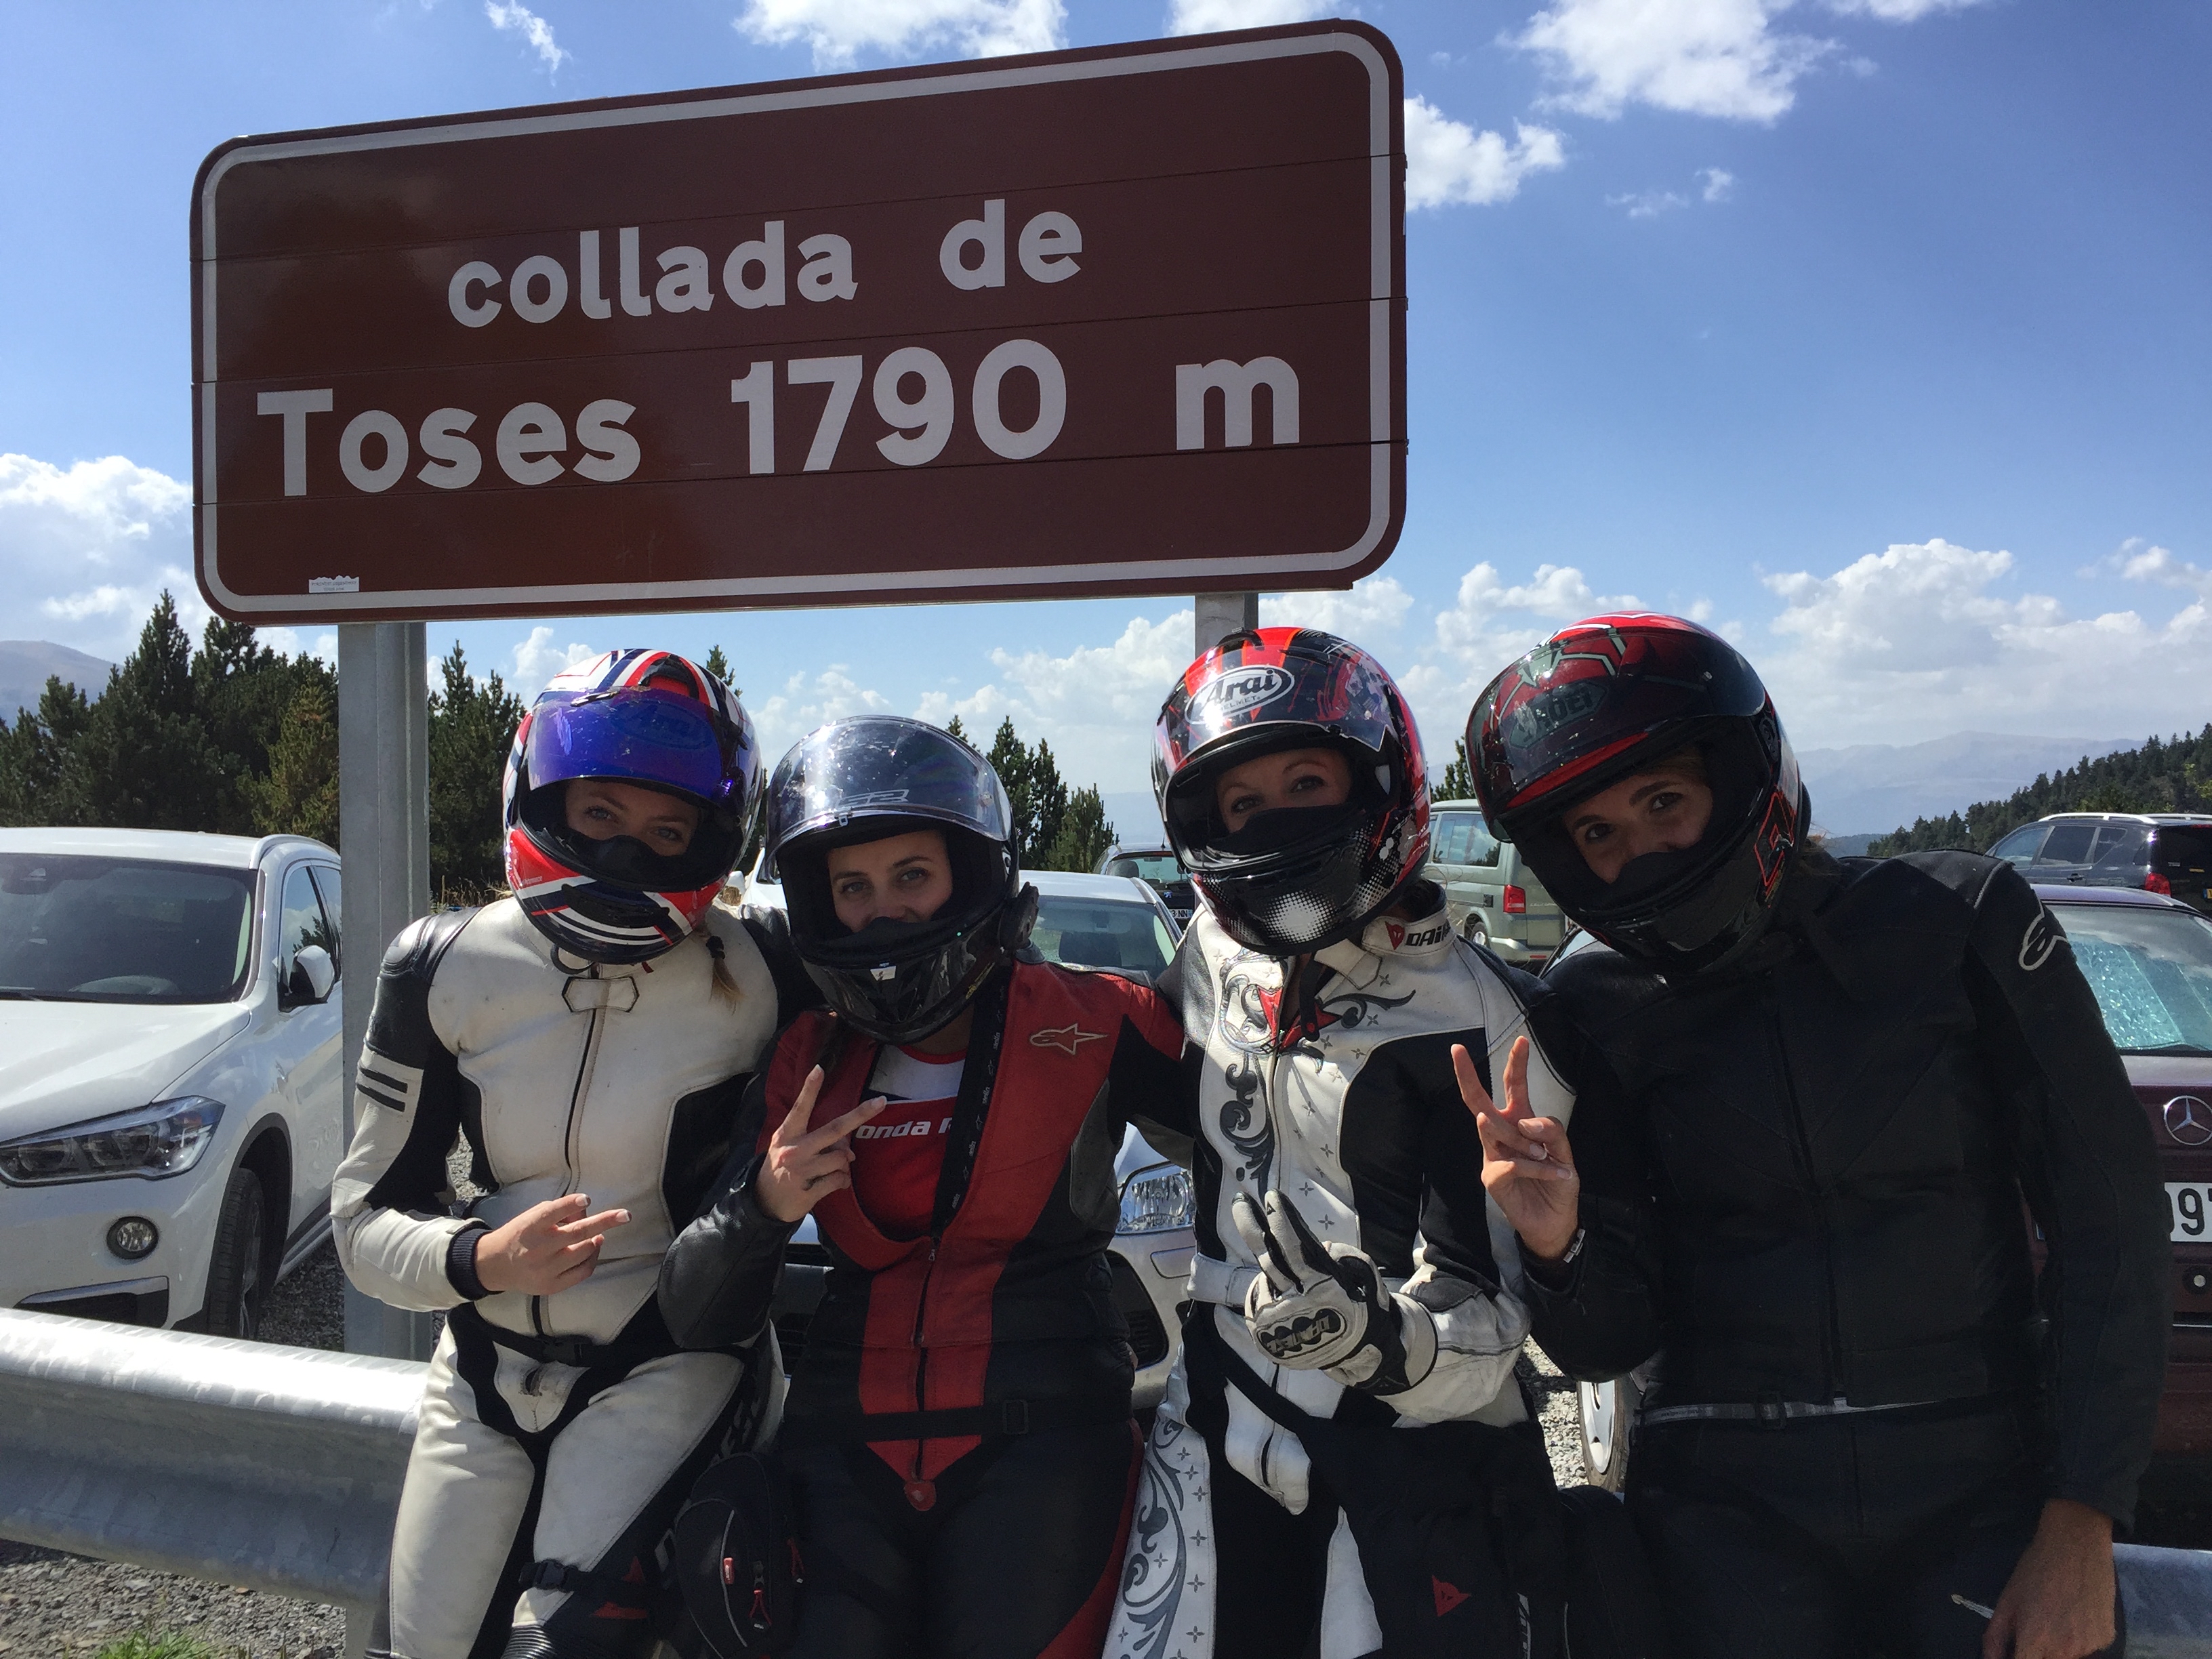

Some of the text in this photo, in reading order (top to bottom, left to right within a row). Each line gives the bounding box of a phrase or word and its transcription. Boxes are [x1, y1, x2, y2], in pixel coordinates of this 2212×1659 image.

[448, 199, 1083, 328] collada de
[257, 338, 1300, 497] Toses 1790 m
[1201, 669, 1278, 710] Arai
[855, 1120, 932, 1139] onda
